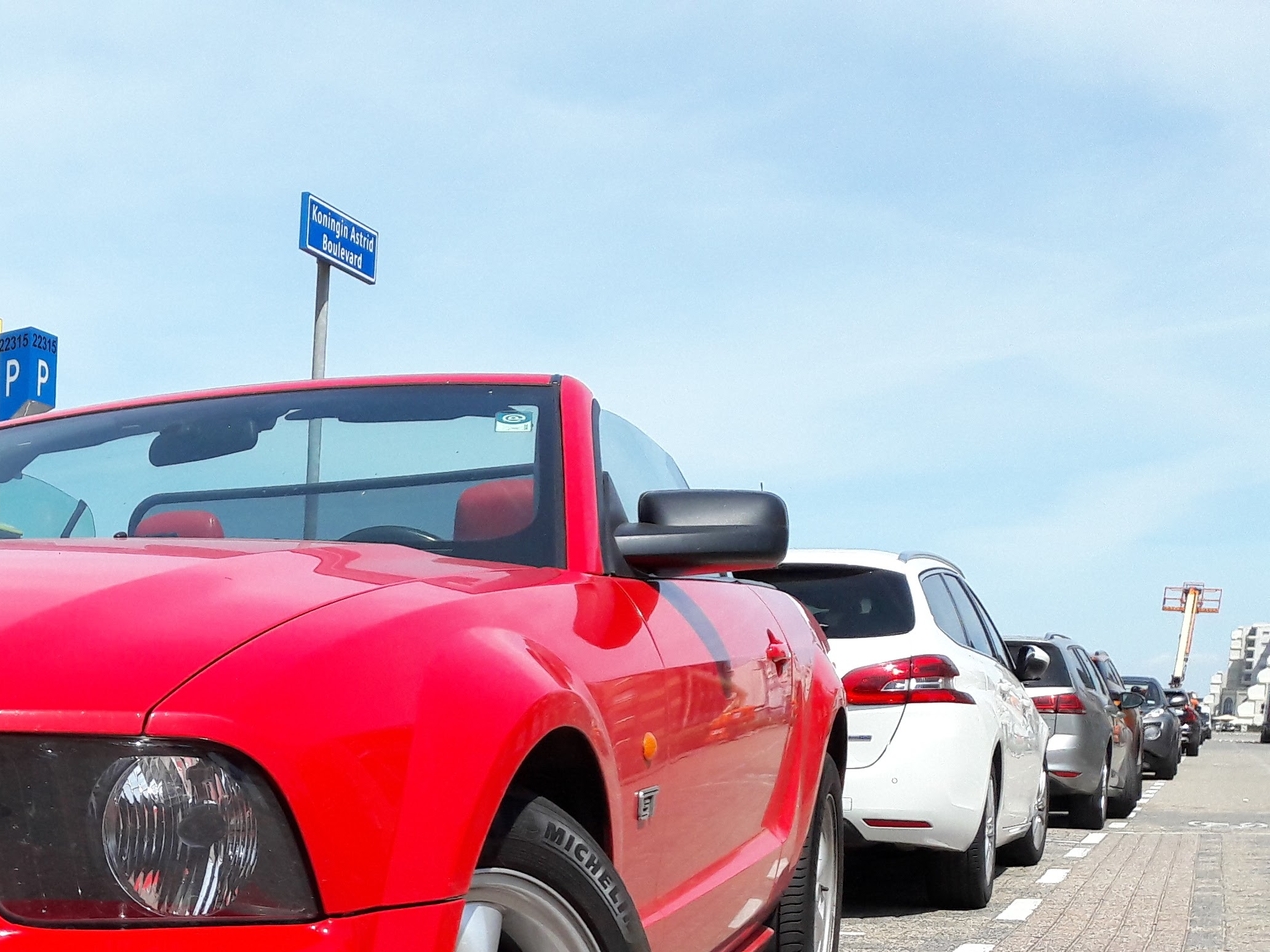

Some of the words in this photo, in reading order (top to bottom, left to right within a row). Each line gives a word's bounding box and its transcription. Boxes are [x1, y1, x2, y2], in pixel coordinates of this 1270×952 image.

[312, 204, 348, 239] Koningin
[350, 227, 374, 253] Astrid
[322, 234, 363, 269] Boulevard
[32, 333, 57, 354] 22315
[5, 359, 20, 397] P
[37, 359, 49, 397] P
